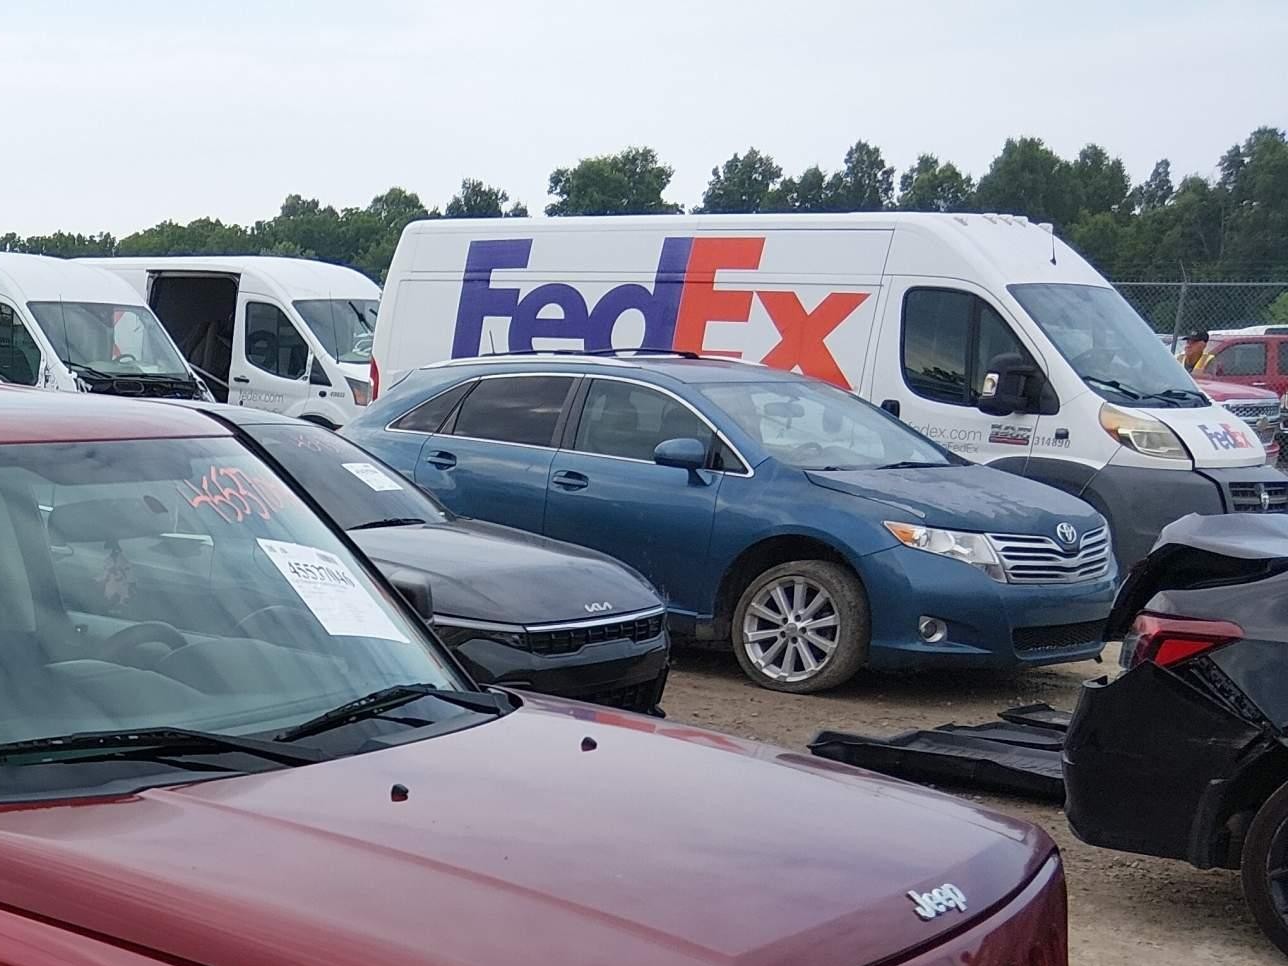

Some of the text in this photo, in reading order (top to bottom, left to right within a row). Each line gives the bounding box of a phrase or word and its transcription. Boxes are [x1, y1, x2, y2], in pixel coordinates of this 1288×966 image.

[451, 236, 872, 390] FedEx
[1197, 422, 1253, 451] FedEx
[906, 882, 968, 918] Jeep
